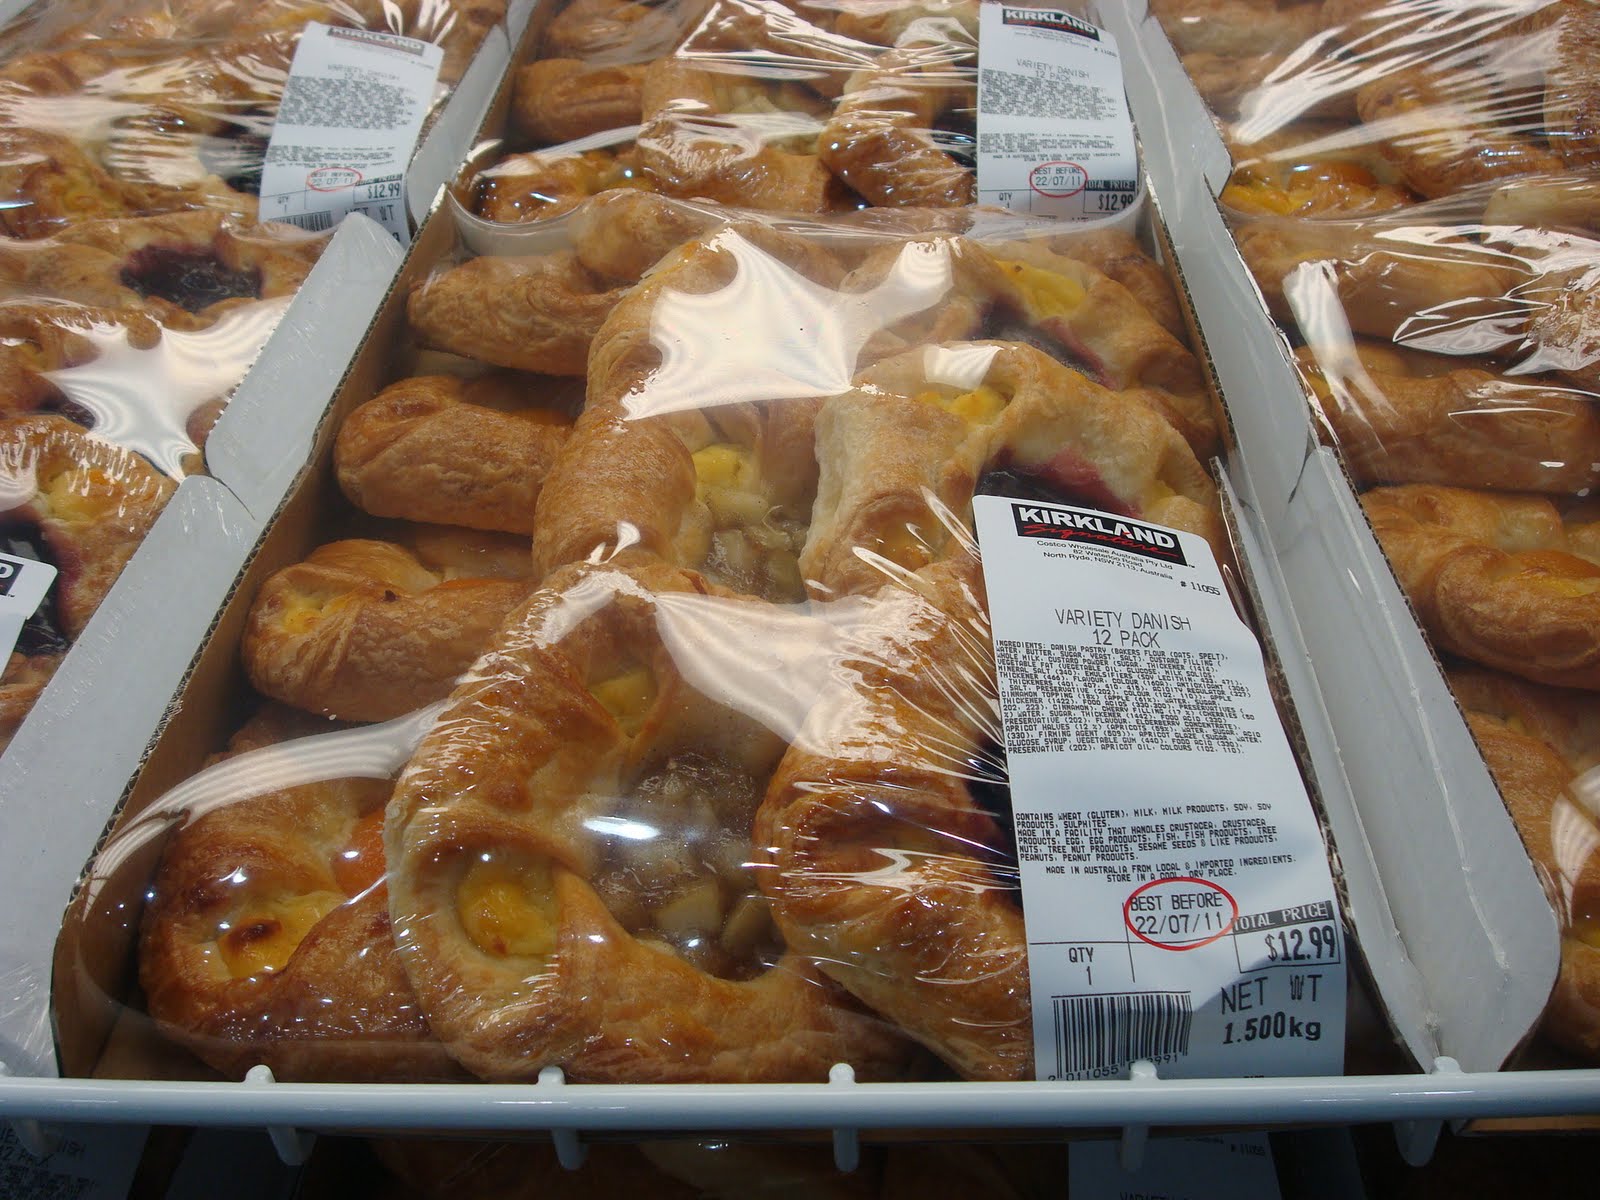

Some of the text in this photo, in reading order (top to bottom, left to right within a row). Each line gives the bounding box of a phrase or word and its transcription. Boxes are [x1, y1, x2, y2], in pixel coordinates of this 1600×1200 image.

[1005, 9, 1095, 33] KIRKLAND
[1016, 58, 1090, 79] VARIETY DANISH
[1035, 70, 1071, 82] 12 PACK
[1034, 167, 1082, 175] BEST BEFORE
[367, 181, 400, 199] $12.99
[1035, 175, 1081, 187] 22/07/11
[998, 192, 1013, 201] QTY
[1018, 507, 1175, 549] KIRKLAND
[1022, 523, 1180, 558] Signature
[1036, 539, 1173, 570] Costco Wholesale Australia Pty Ltd
[1084, 550, 1121, 561] Waterloo
[1122, 556, 1143, 568] Road
[1043, 552, 1173, 580] North Ryde, NSW 2113, Australia
[1180, 580, 1221, 597] # 11055
[1054, 608, 1192, 631] VARIETY DANISH
[1093, 629, 1161, 649] 12 PACK
[996, 640, 1046, 650] INGREDIENTS:
[1050, 644, 1077, 652] DANISH
[1080, 645, 1106, 655] PASTRY
[1111, 648, 1140, 657] (BAKERS
[1199, 652, 1228, 661] SPELT),
[1006, 724, 1037, 732] APRICOT
[1212, 728, 1238, 736] SUGAR,
[1175, 732, 1197, 740] GLAZE
[1202, 734, 1231, 742] (SUGAR,
[1008, 744, 1064, 754] PRESERVATIVE
[1172, 738, 1190, 746] FOOD
[1016, 803, 1272, 820] CONTAINS WHEAT (GLUTEN), MILK, MILK PRODUCTS, SOY, SOY
[1018, 818, 1266, 837] MADE IN A FACILITY THAT HANDLES CRUSTACEA, CRUSTACEA
[1063, 820, 1110, 828] SULPHITES.
[1018, 826, 1277, 845] PRODUCTS, EGG, EGG PRODUCTS, FISH, FISH PRODUCTS, TREE
[1020, 846, 1042, 854] NUTS,
[1047, 845, 1067, 854] TREE
[1071, 845, 1085, 853] NUT
[1090, 844, 1133, 853] PRODUCTS,
[1138, 841, 1168, 851] SESAME
[1172, 839, 1196, 849] SEEDS
[1210, 838, 1230, 846] LIKE
[1234, 835, 1278, 845] PRODUCTS,
[1020, 852, 1139, 862] PEANUTS, PEANUT PRODUCTS.
[1046, 866, 1065, 874] MADE
[1071, 866, 1080, 874] IN
[1084, 865, 1128, 874] AUSTRALIA
[1132, 864, 1152, 873] FROM
[1156, 862, 1181, 872] LOCAL
[1196, 858, 1234, 869] IMPORTED
[1240, 855, 1296, 866] INGREDIENTS.
[1107, 868, 1237, 882] STORE IN A COOL, DRY PLACE.
[1130, 892, 1223, 912] BEST BEFORE
[1135, 911, 1223, 935] 22/07/11
[1233, 902, 1328, 931] TOTAL PRICE
[1264, 924, 1336, 962] $12.99
[1069, 947, 1093, 963] QTY
[1086, 966, 1092, 986] 1
[1221, 974, 1322, 1014] NET WT
[1223, 1011, 1322, 1044] 1.500kg
